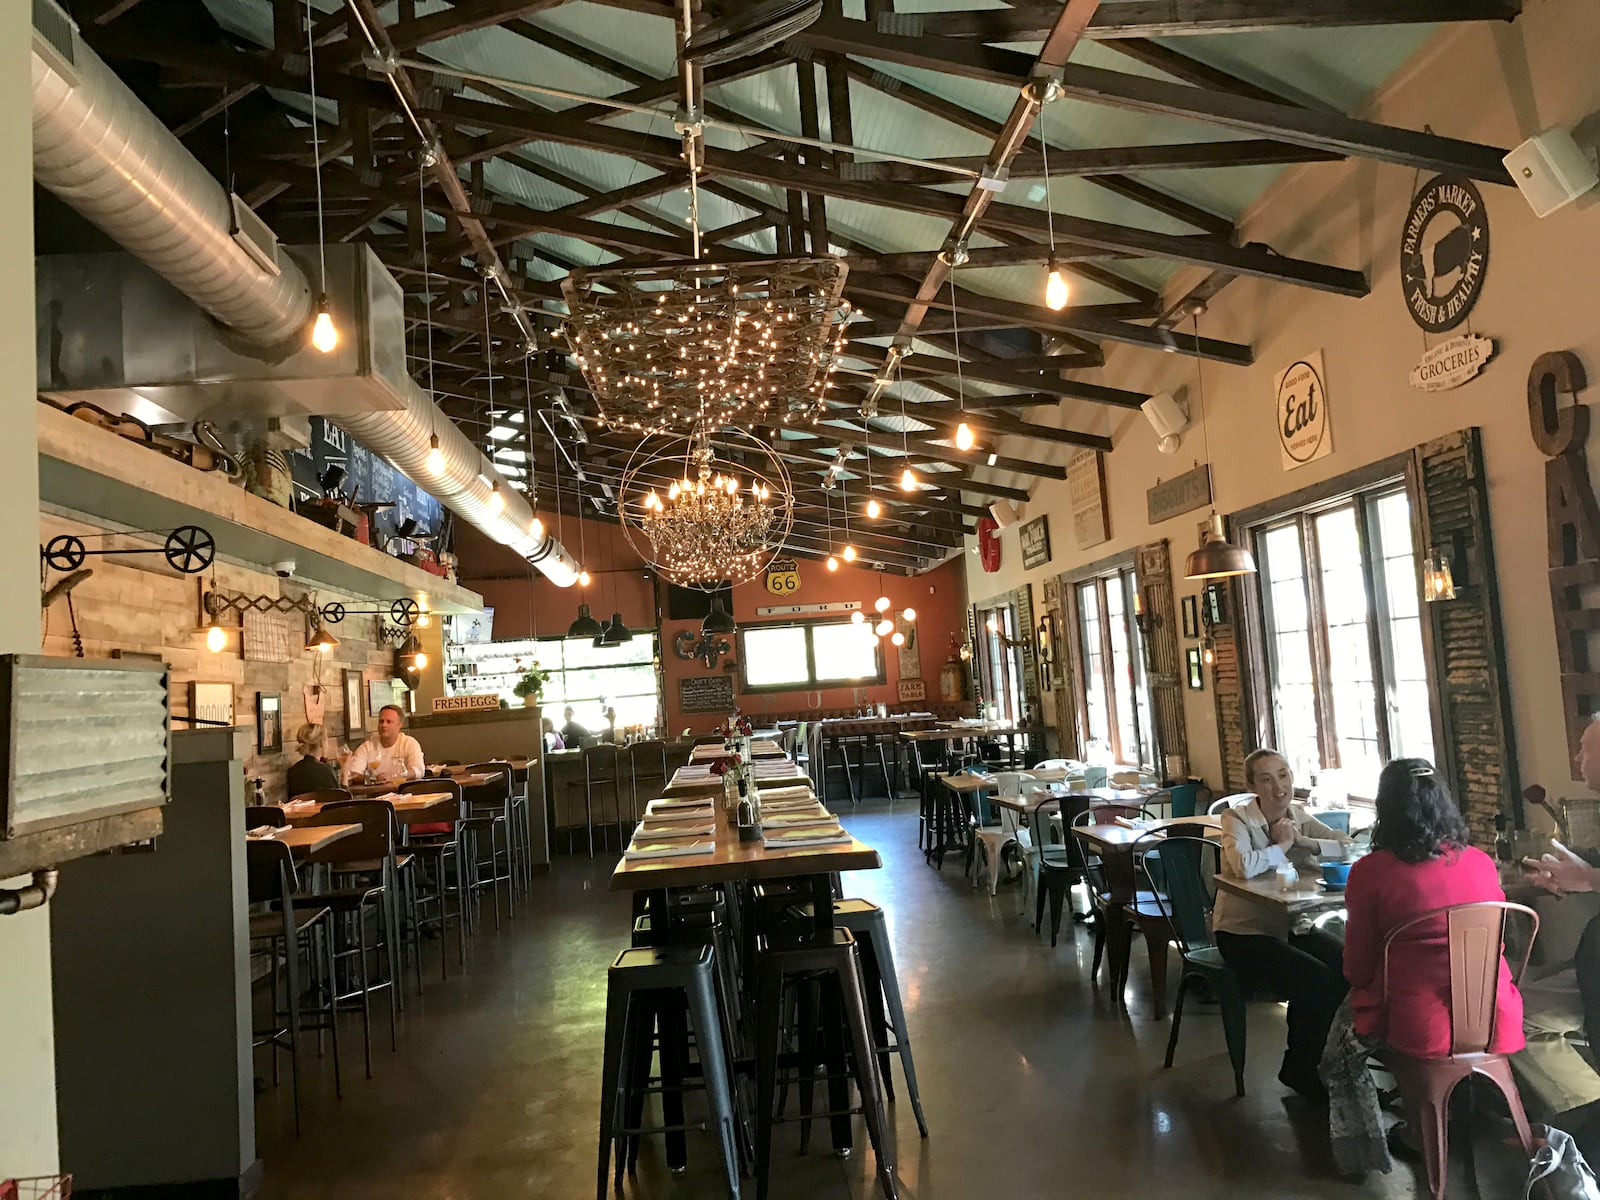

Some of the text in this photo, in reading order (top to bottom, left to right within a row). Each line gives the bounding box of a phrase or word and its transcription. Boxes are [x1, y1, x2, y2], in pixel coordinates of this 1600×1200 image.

[1404, 184, 1476, 255] FARMERS' MARKET
[1410, 249, 1483, 324] FRESH & HEALTHY
[1420, 345, 1480, 381] GROCERIES
[1284, 382, 1317, 438] Eat
[1151, 475, 1200, 516] BISCUITS
[770, 563, 795, 572] ROUTE
[772, 575, 796, 590] 66
[900, 682, 922, 691] FARM
[901, 691, 923, 699] TABLE
[435, 695, 497, 709] FRESH EGGS
